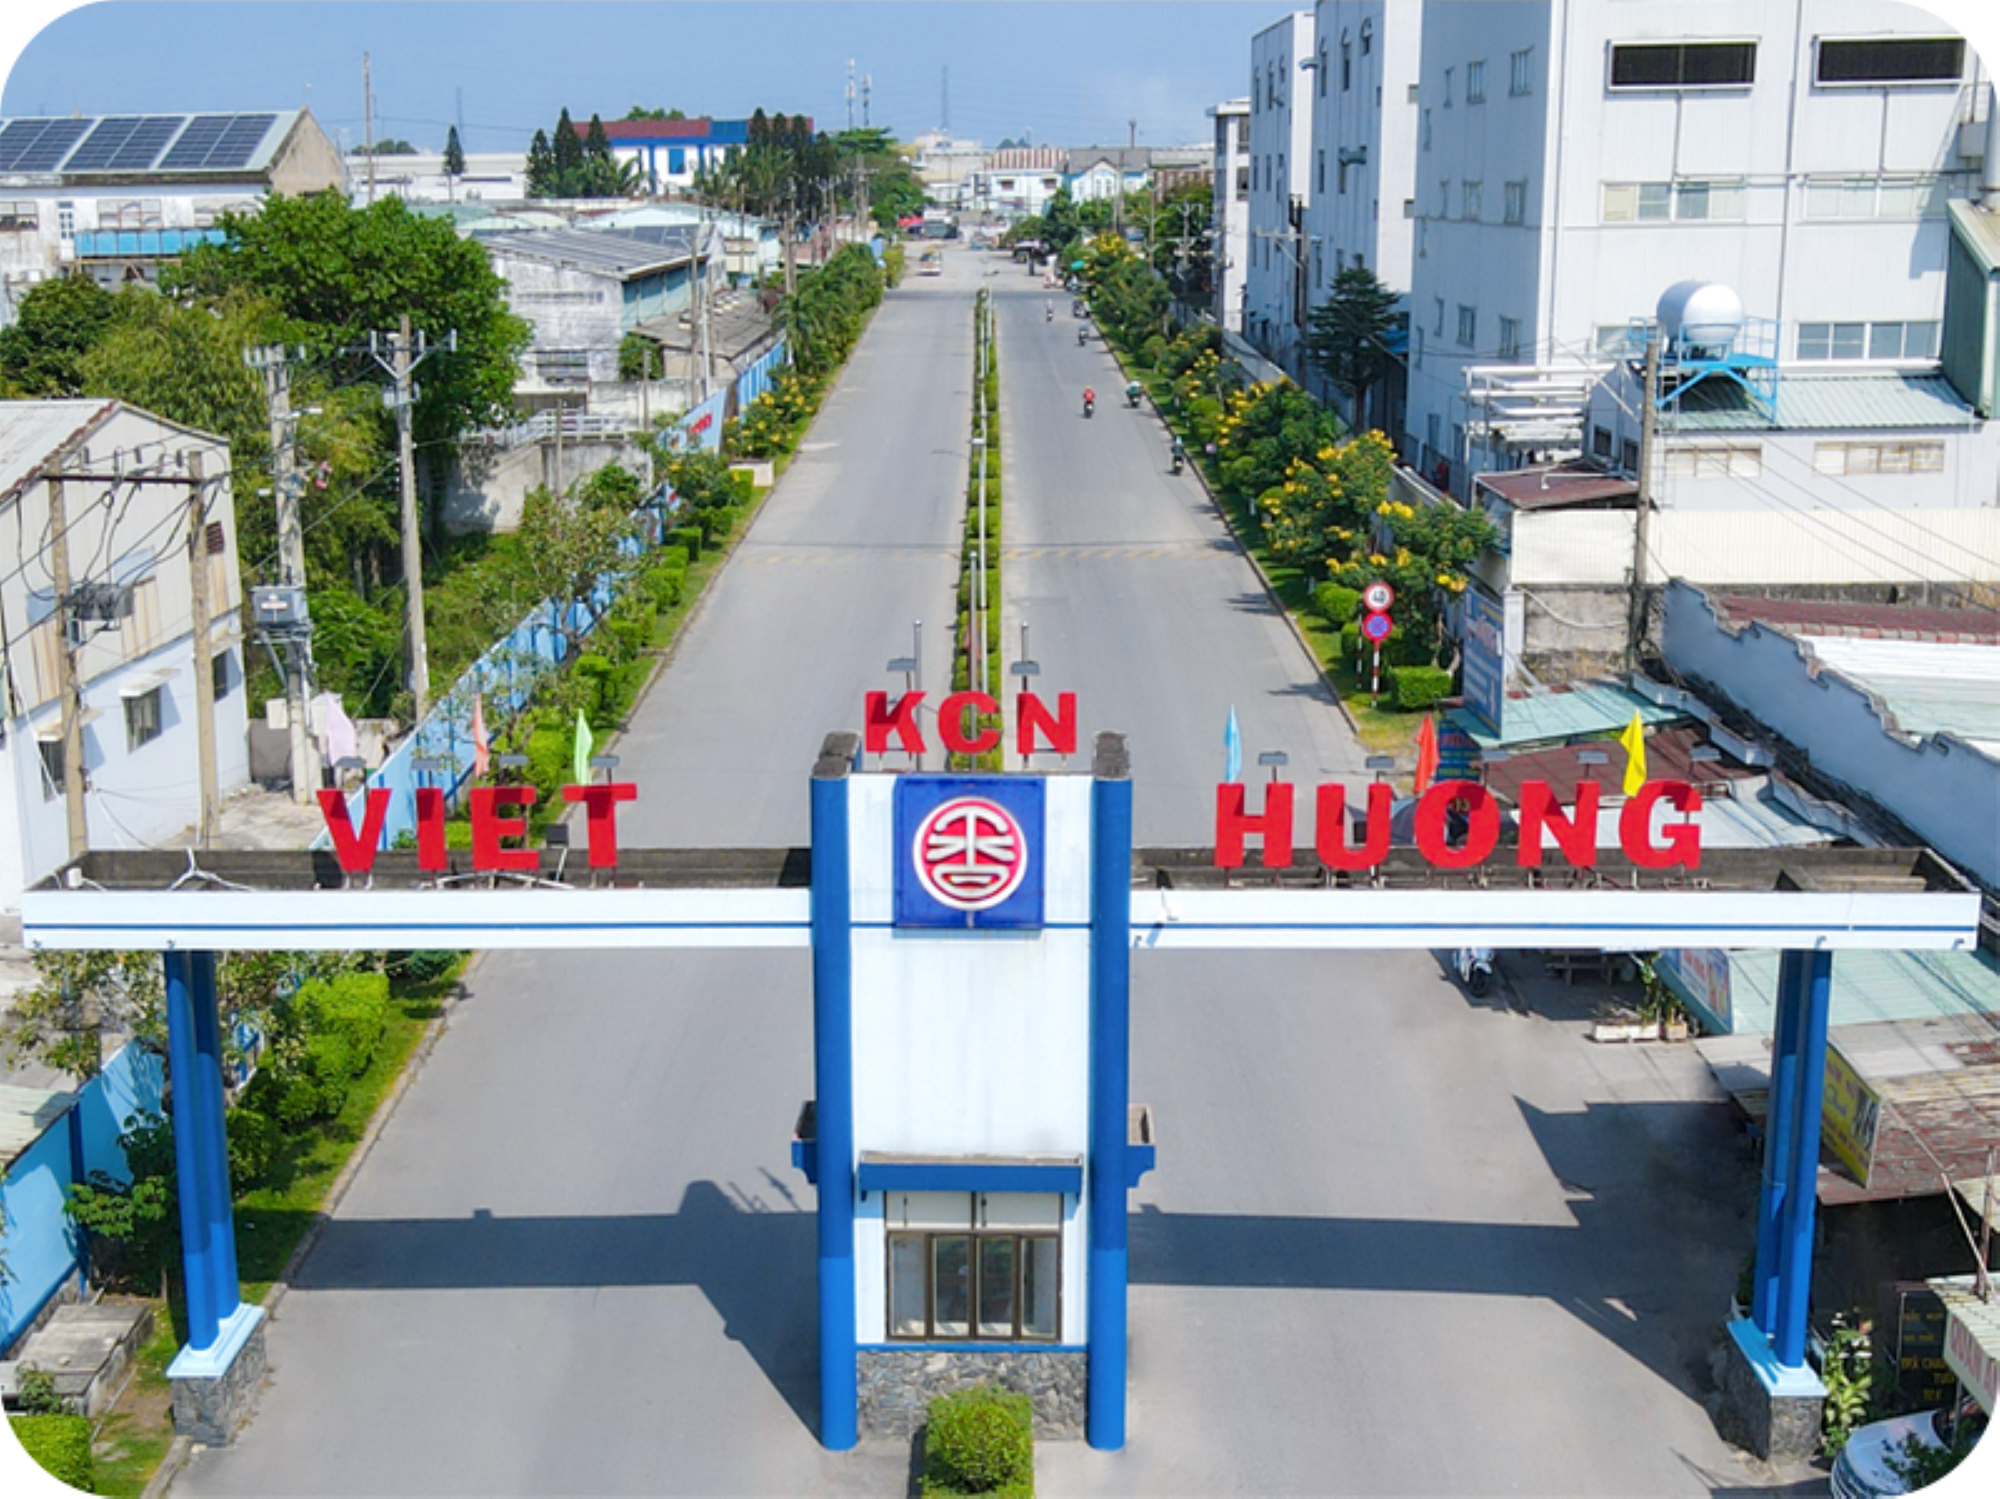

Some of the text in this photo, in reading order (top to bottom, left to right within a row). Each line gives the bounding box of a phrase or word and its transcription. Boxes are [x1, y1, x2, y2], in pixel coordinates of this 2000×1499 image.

[866, 690, 1078, 757] KCN
[317, 779, 1705, 873] VIET HUONG
